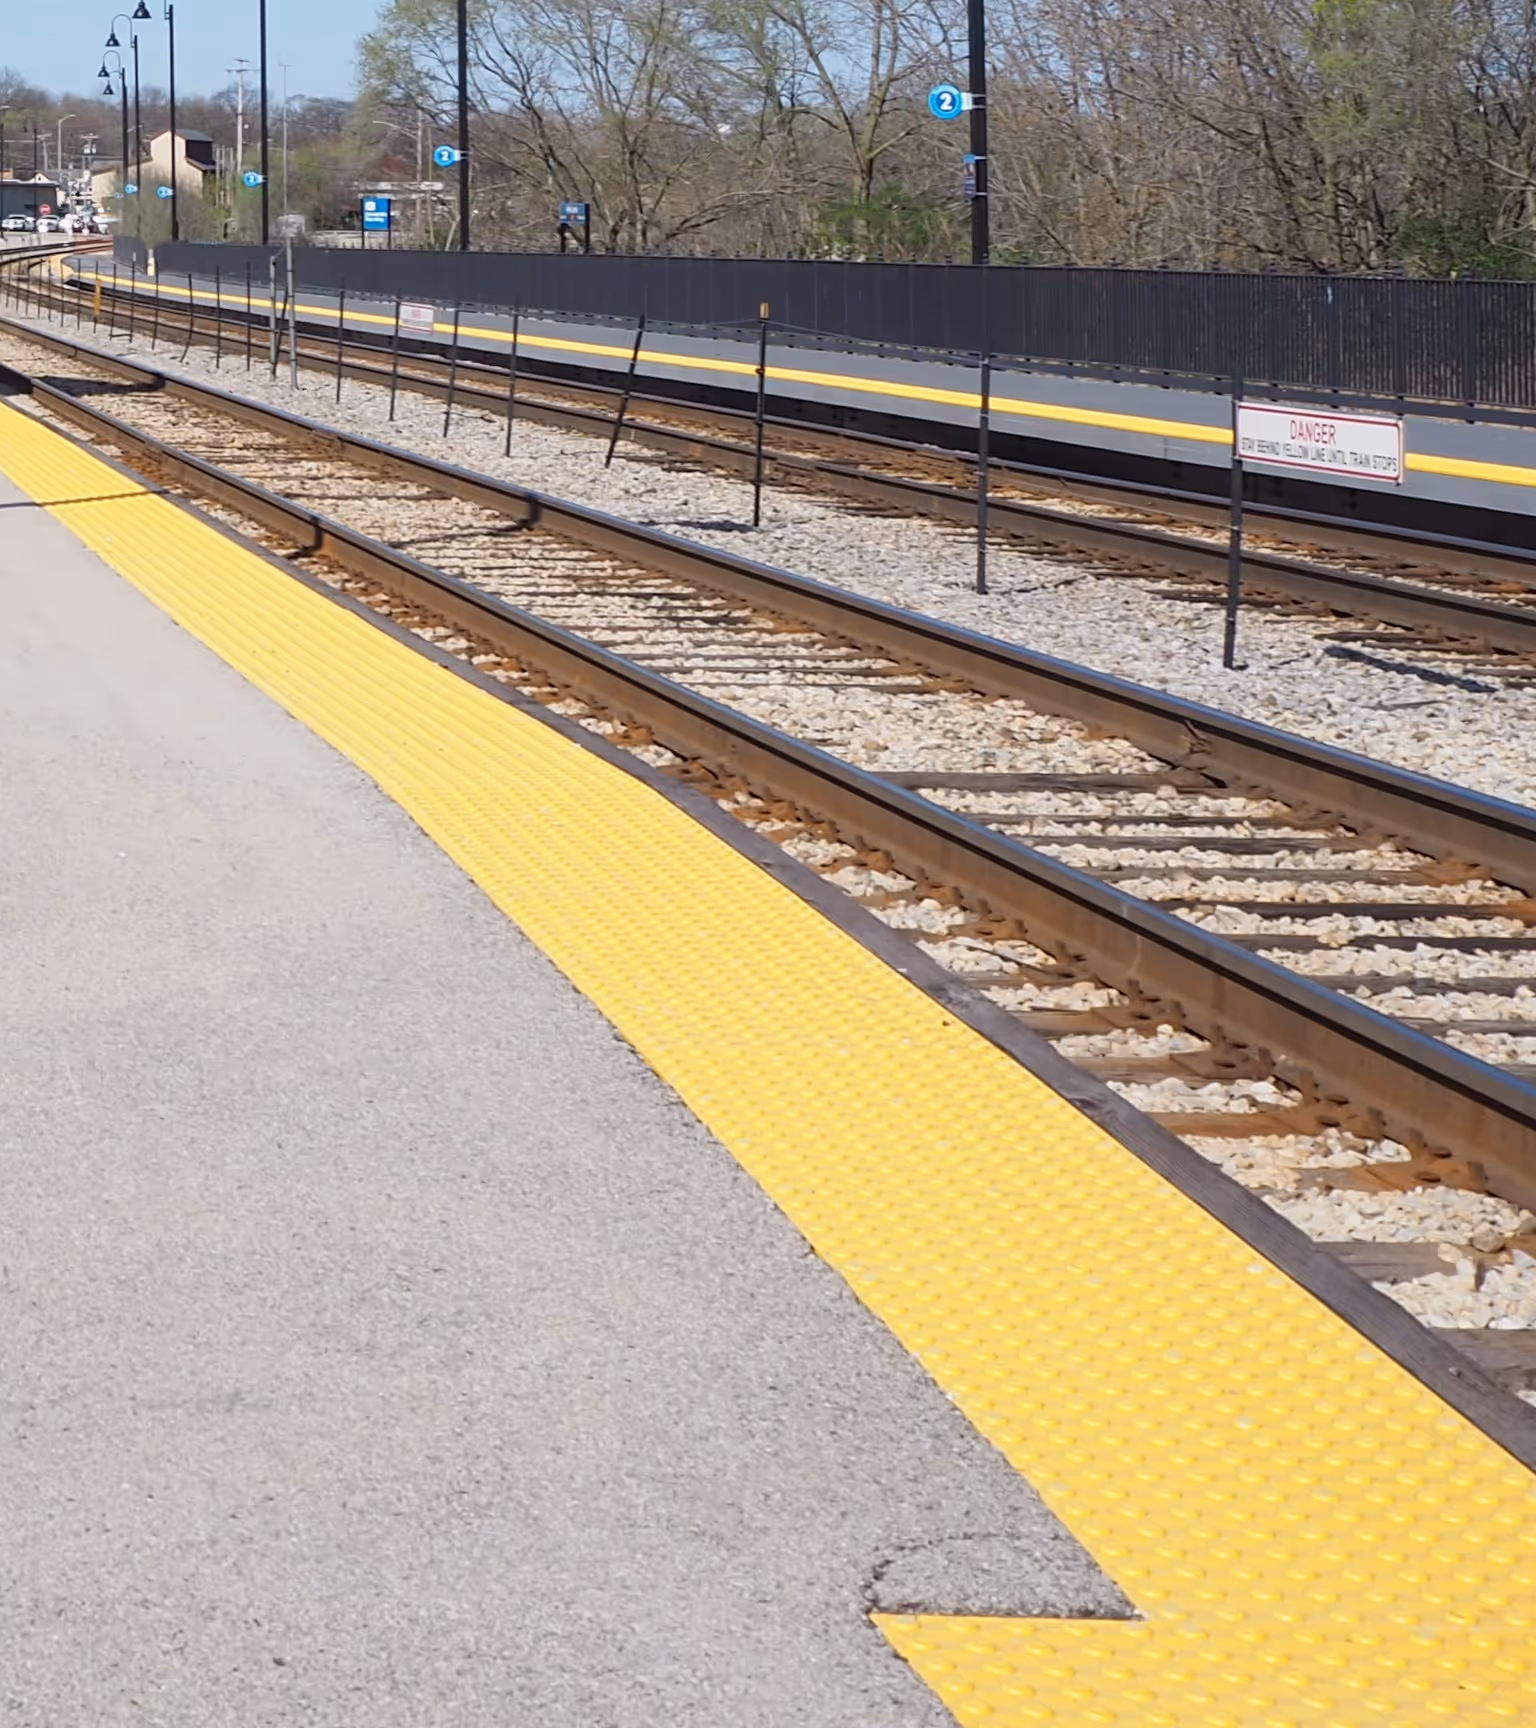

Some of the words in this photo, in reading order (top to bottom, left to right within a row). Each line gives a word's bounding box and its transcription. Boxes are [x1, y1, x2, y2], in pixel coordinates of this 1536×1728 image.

[939, 92, 953, 111] 2
[440, 150, 449, 161] 2
[1289, 419, 1337, 445] DANGER
[1349, 451, 1370, 468] TRAIN
[1372, 454, 1397, 473] STOPS
